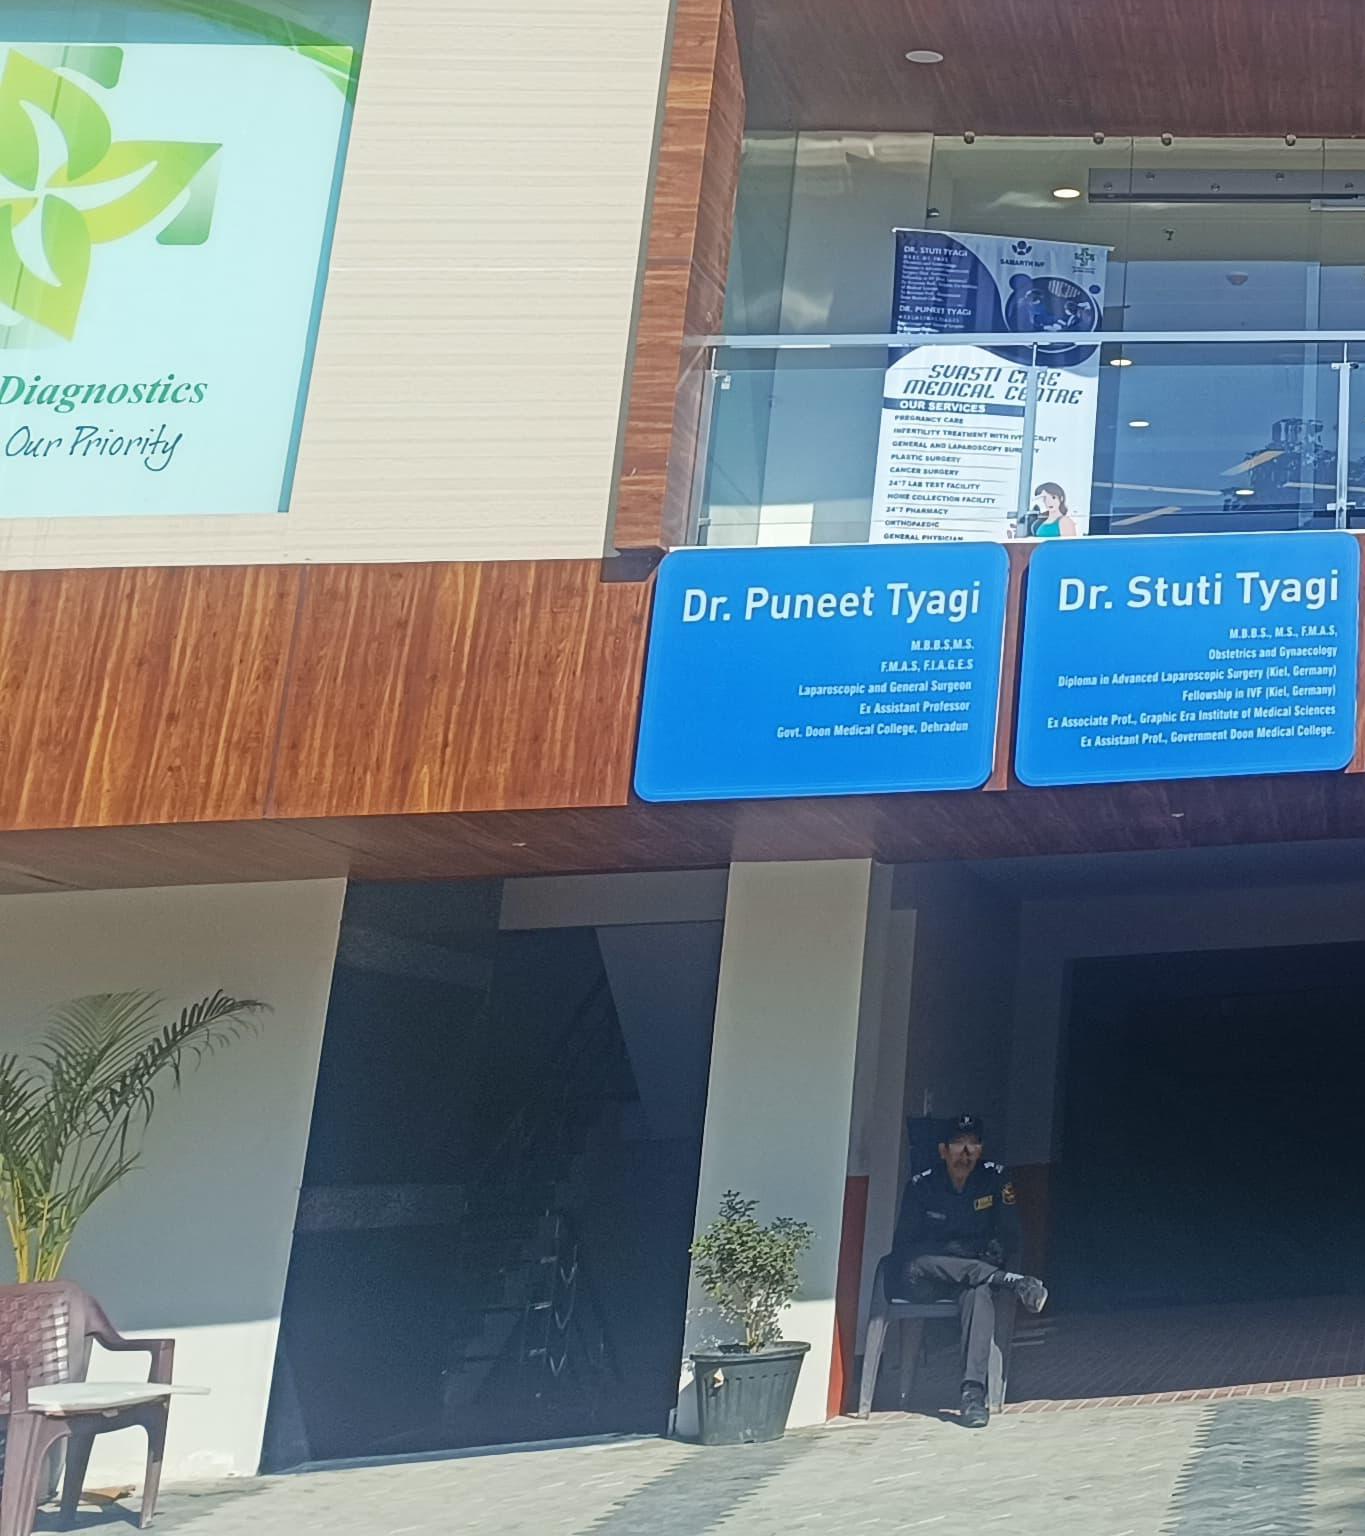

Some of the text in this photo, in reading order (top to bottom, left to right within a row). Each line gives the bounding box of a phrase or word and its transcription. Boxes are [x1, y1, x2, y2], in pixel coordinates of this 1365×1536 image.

[0, 374, 208, 413] Diagnostics
[903, 380, 995, 399] MEDICAL
[900, 400, 986, 413] OUR SERVICES
[5, 424, 183, 472] Our Priority
[1058, 569, 1339, 611] Dr. Stuti Tyagi
[682, 581, 981, 623] Dr. Puneet Tyagi
[1209, 645, 1337, 660] Obstetrics and Gynaecology
[1058, 675, 1097, 688] Diploma
[1100, 674, 1109, 685] in
[1111, 672, 1159, 684] Advanced
[1161, 669, 1224, 683] Laparoscopic
[1227, 668, 1264, 680] Surgery
[1293, 665, 1337, 677] Germany)
[799, 680, 971, 698] Laparoscopic and General Surgeon
[1183, 688, 1232, 702] Fellowship
[1235, 688, 1244, 699] in
[1247, 687, 1262, 698] IVF
[1292, 684, 1336, 697] Germany)
[859, 701, 971, 714] Ex Assistant Professor
[1048, 717, 1058, 728] Ex
[1061, 716, 1108, 728] Associate
[1140, 711, 1177, 725] Graphic
[1180, 710, 1195, 721] Era
[1199, 709, 1239, 721] Institute
[1241, 708, 1251, 719] of
[1254, 706, 1291, 717] Medical
[1294, 705, 1336, 716] Sciences
[805, 726, 830, 737] Doon
[834, 724, 874, 736] Medical
[920, 721, 969, 733] Dehradun
[1081, 736, 1092, 747] Ex
[1094, 734, 1139, 747] Assistant
[1170, 730, 1227, 743] Government
[1230, 728, 1254, 740] Doon
[1257, 726, 1294, 738] Medical
